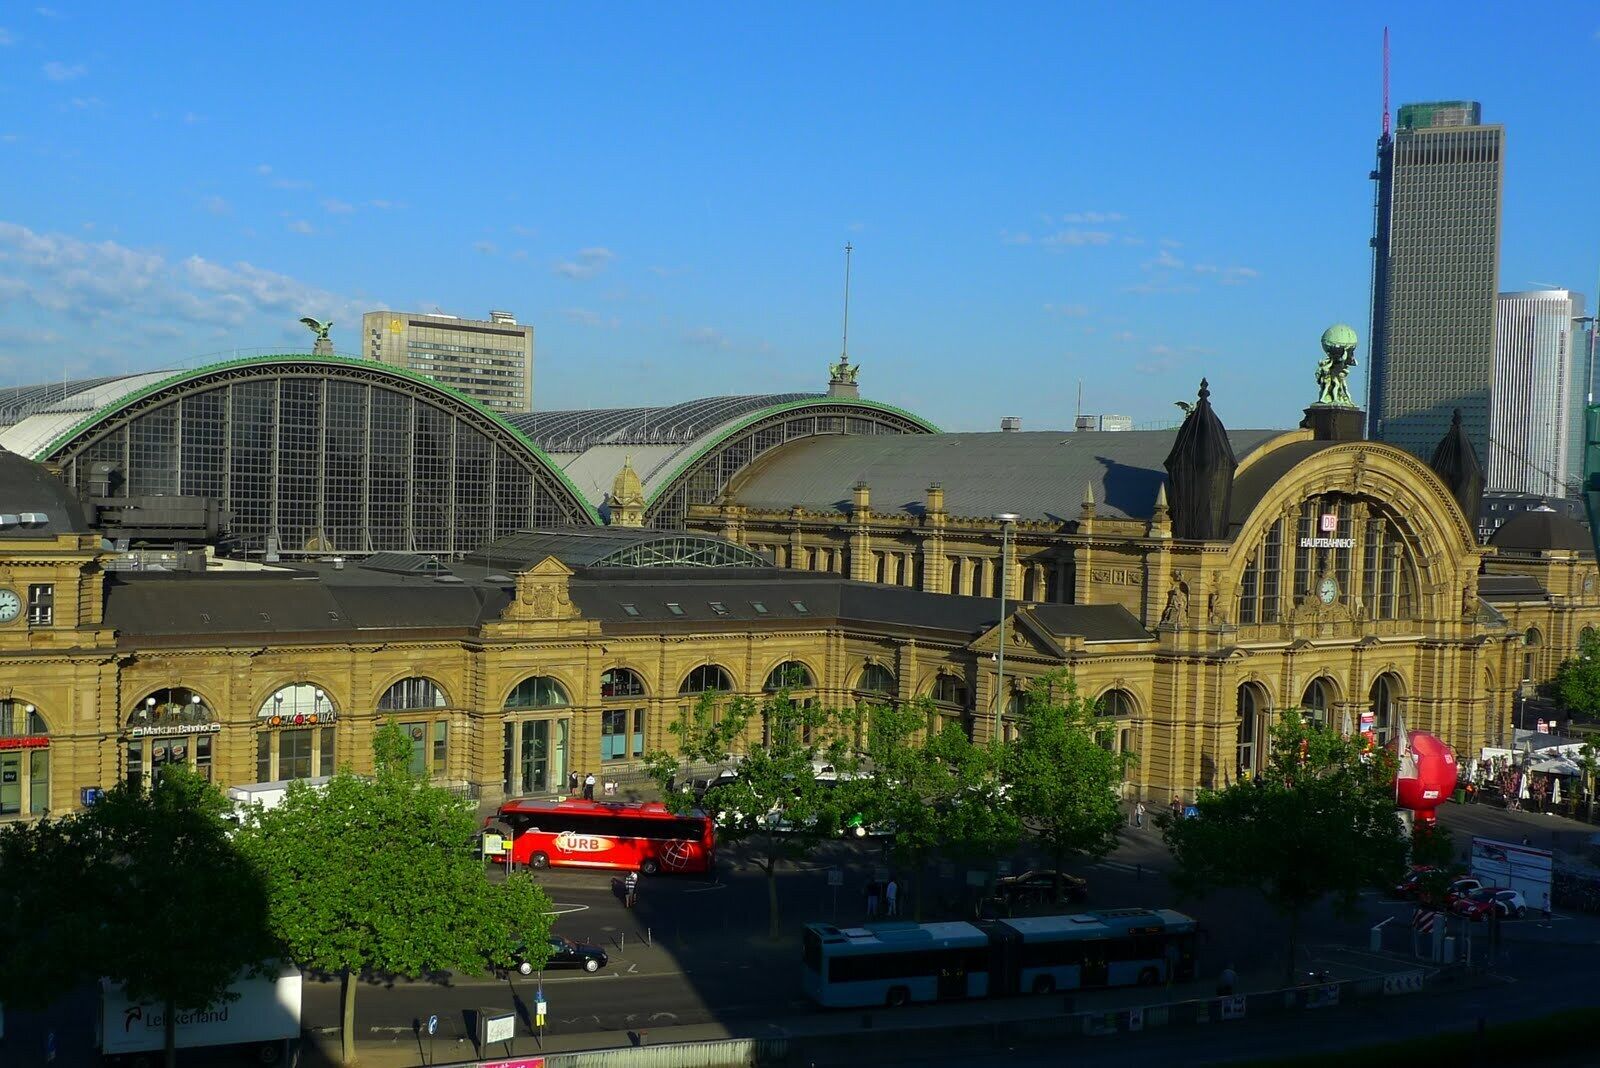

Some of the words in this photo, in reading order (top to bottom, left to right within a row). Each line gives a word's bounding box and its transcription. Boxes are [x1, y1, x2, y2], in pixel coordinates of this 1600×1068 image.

[1324, 516, 1335, 529] DB
[1301, 538, 1356, 548] HAUPTBAHNHOF
[567, 838, 600, 850] URB
